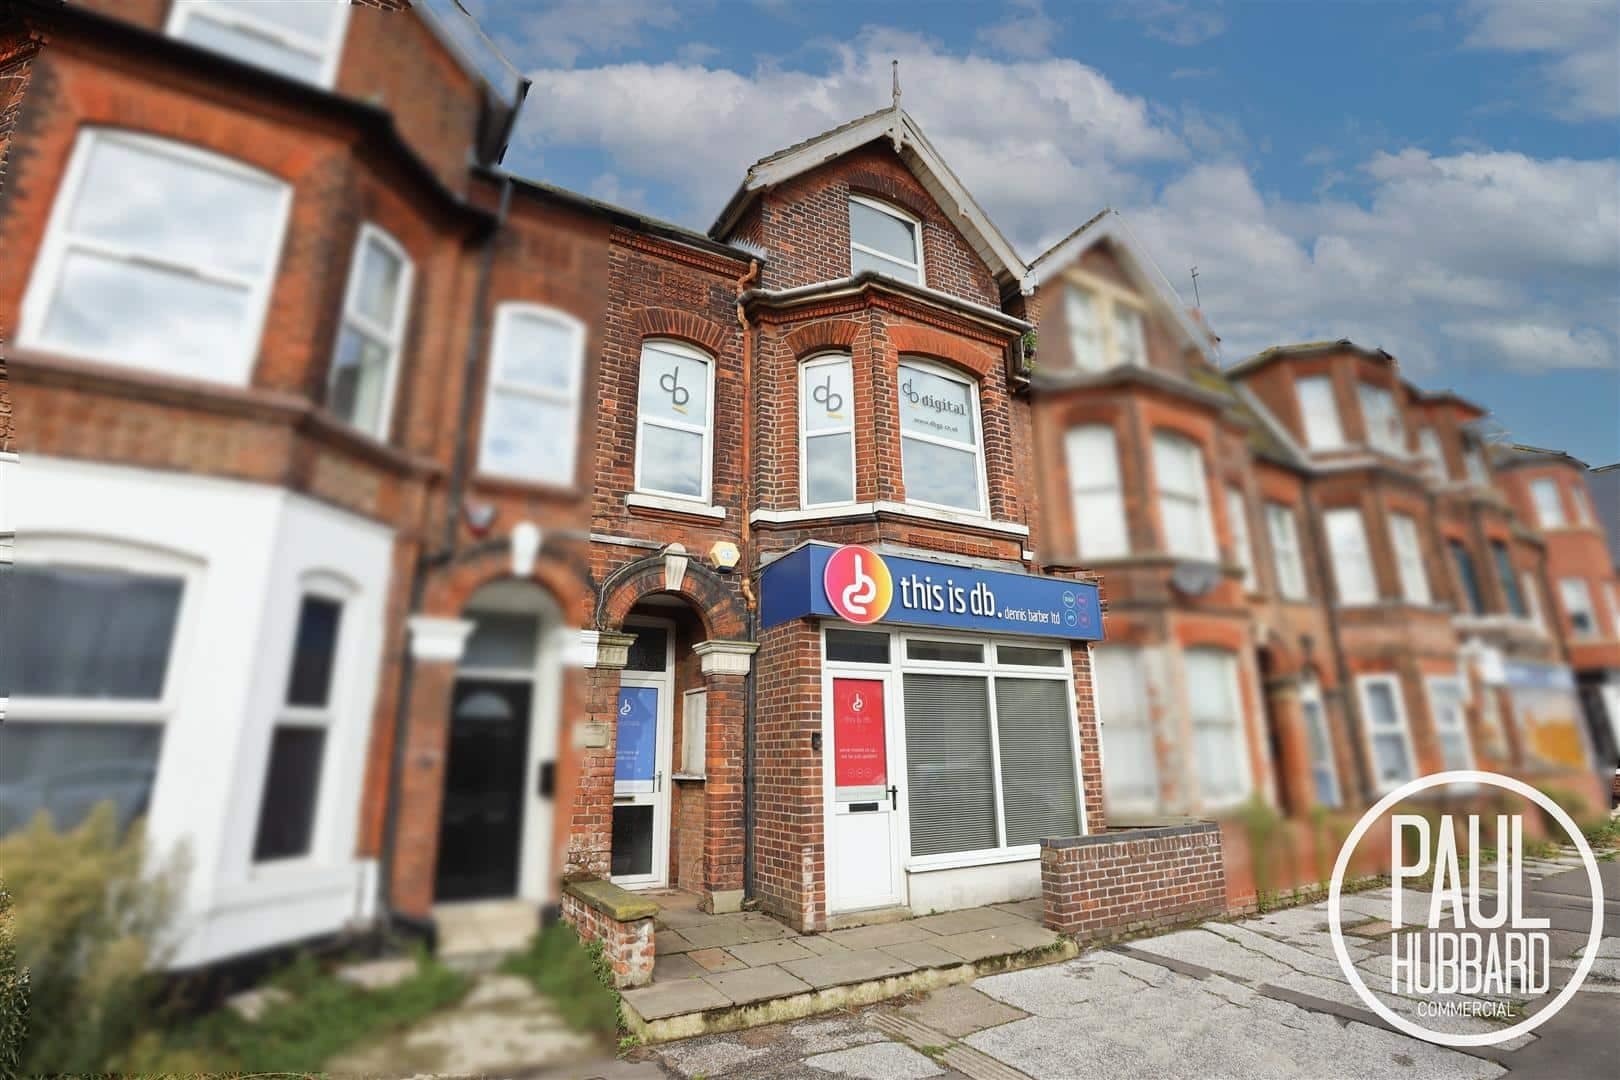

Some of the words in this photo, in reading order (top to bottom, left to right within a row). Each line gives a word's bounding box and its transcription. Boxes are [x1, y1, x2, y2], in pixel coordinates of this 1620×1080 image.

[922, 395, 966, 415] digital
[900, 573, 944, 612] this
[947, 579, 967, 614] is
[970, 581, 1003, 619] db.
[1005, 606, 1027, 621] dennis
[1028, 609, 1049, 623] barber
[1051, 611, 1060, 624] ltd
